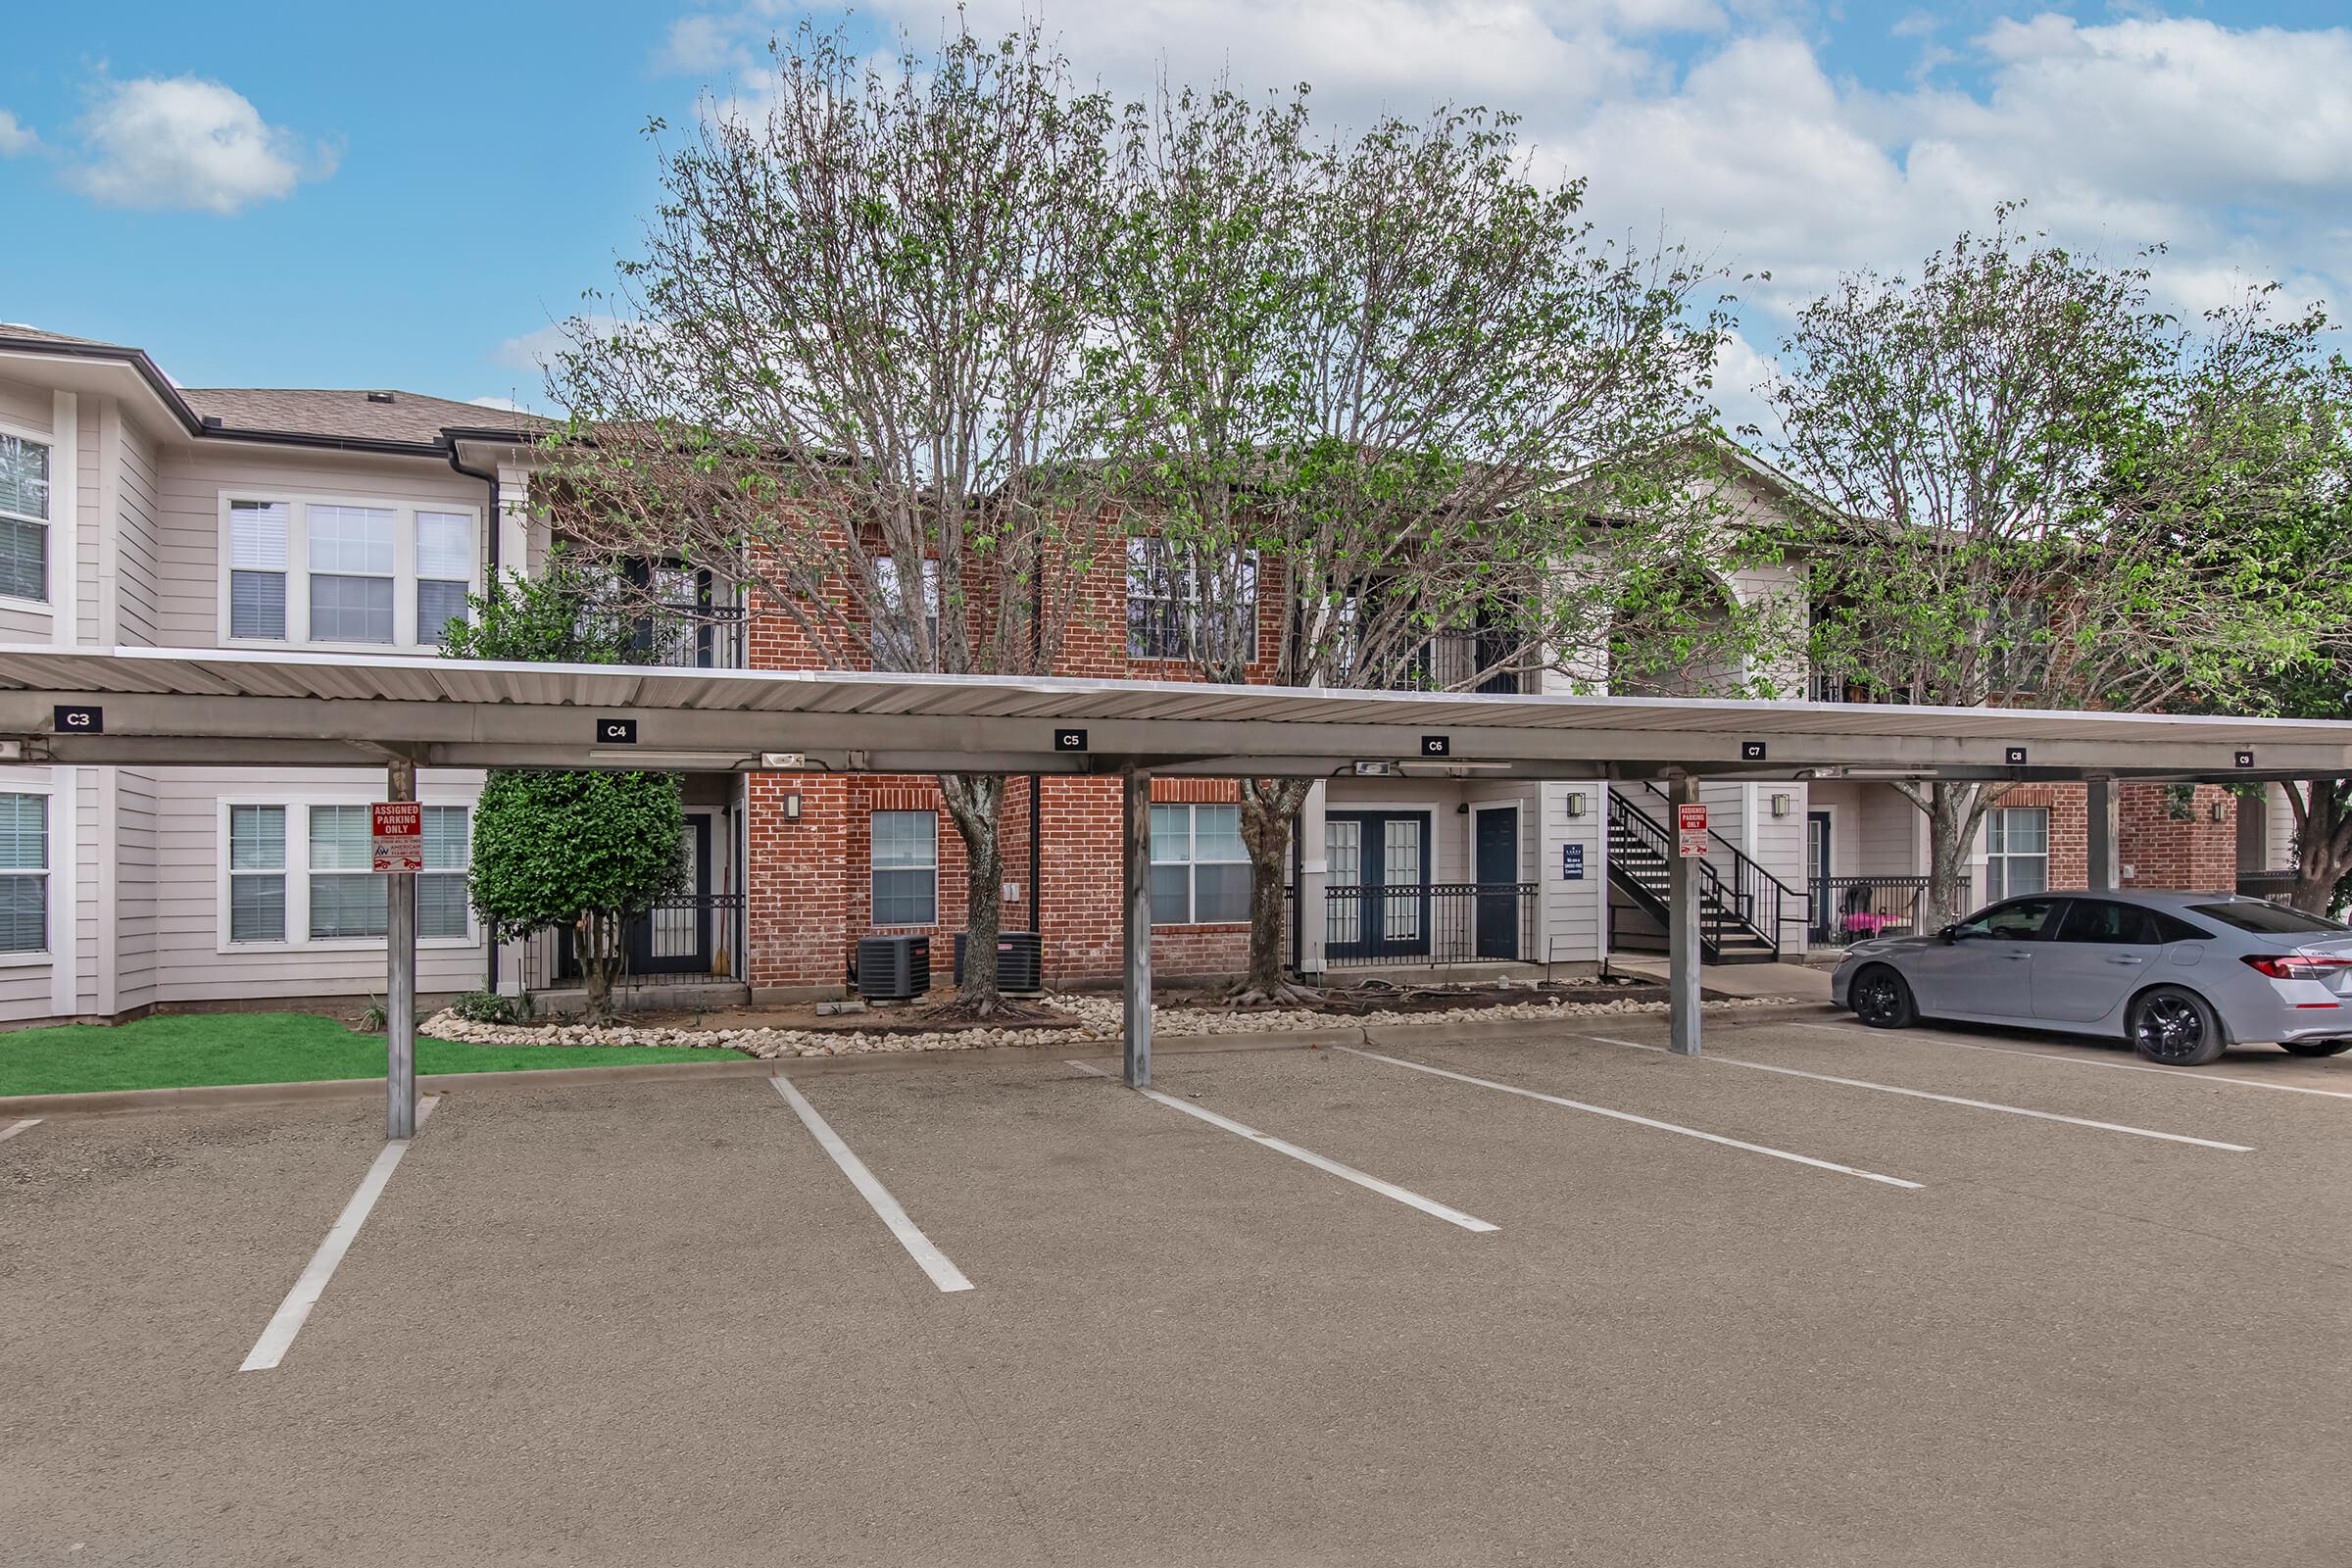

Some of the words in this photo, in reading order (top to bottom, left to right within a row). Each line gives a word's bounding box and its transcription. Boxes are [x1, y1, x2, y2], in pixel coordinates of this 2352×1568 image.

[68, 713, 89, 726] C3
[607, 726, 627, 737] C4
[1063, 735, 1080, 746] C5
[1429, 742, 1443, 752] C6
[1748, 747, 1760, 756] C7
[2011, 752, 2022, 760] C8
[2239, 756, 2250, 764] C9
[374, 806, 418, 814] ASSIGNED
[376, 815, 416, 824] PARKING
[385, 825, 409, 834] ONLY
